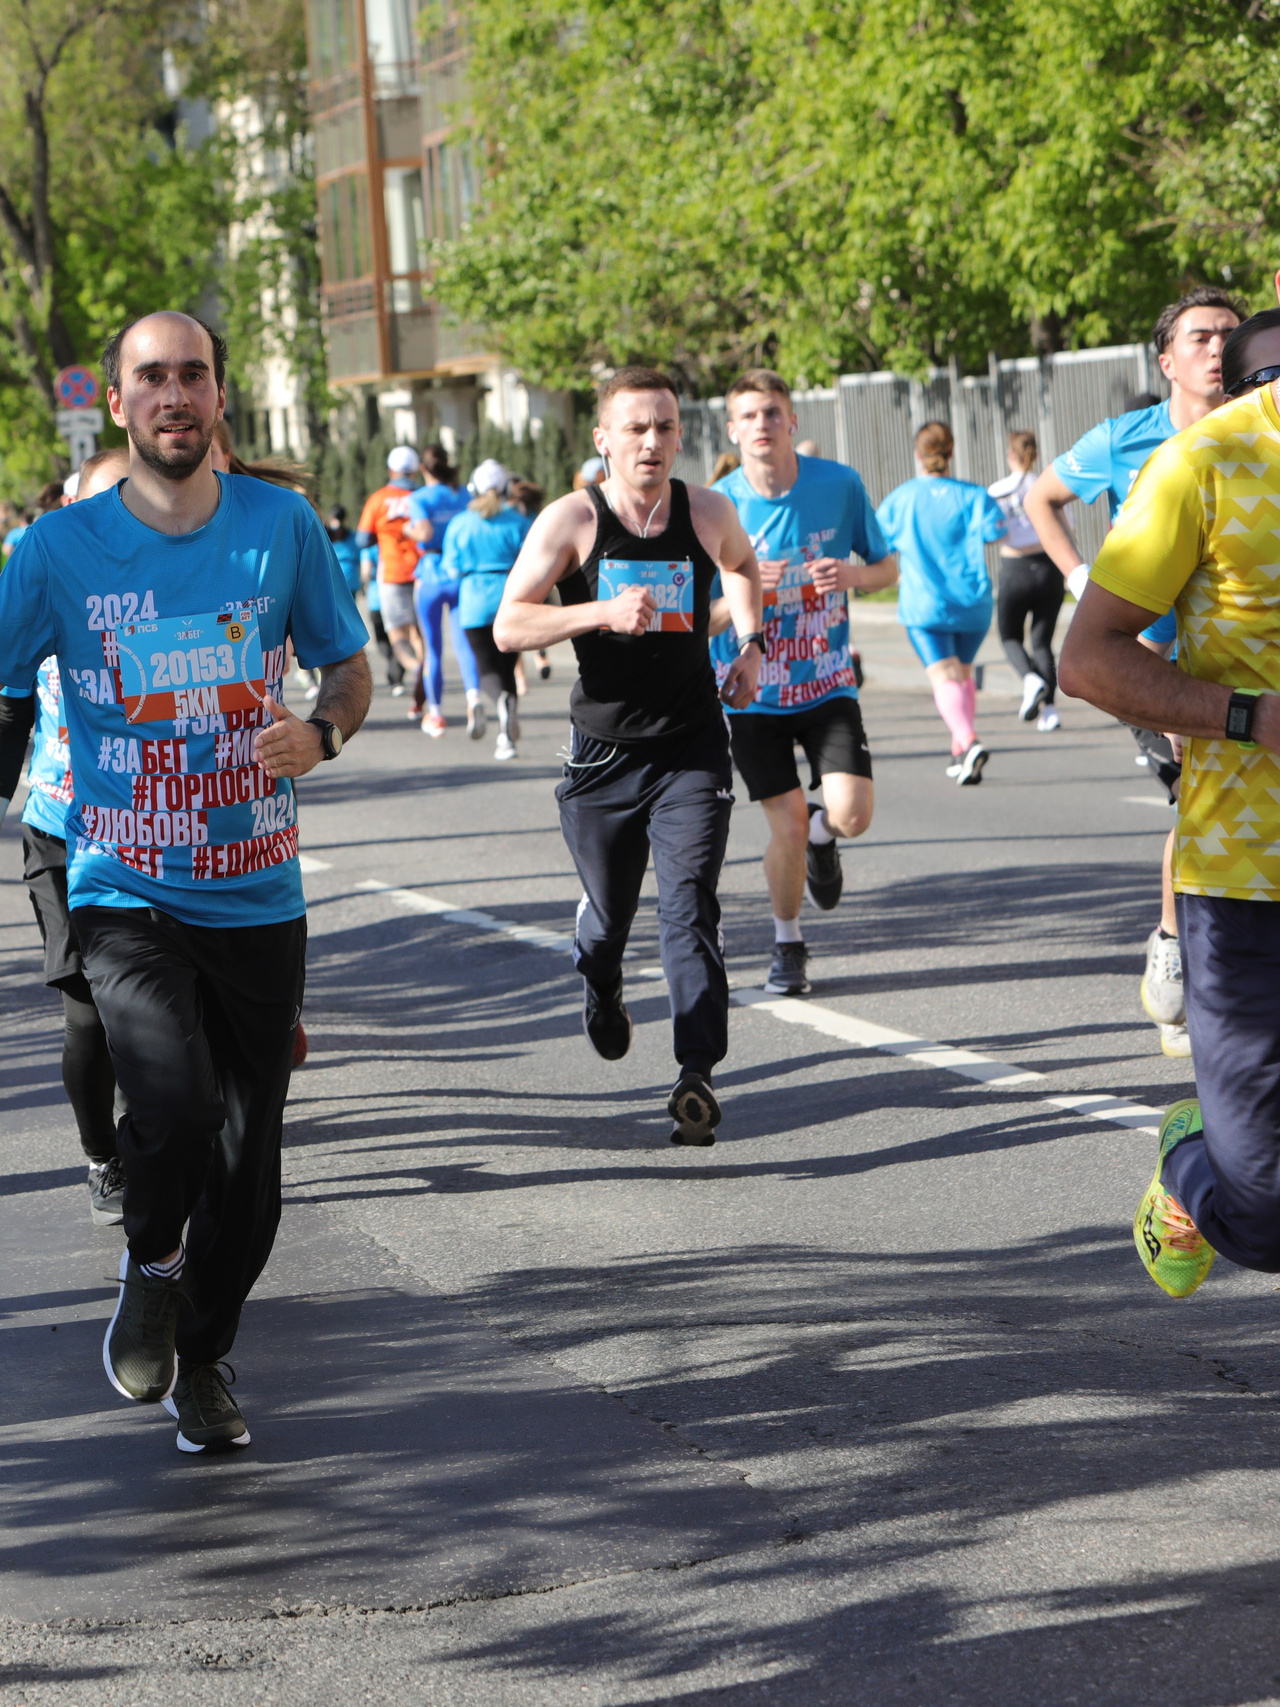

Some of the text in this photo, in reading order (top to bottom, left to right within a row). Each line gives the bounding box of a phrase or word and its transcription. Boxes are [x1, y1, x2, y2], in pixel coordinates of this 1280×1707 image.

[86, 590, 158, 631] 2024
[137, 623, 159, 634] ПСБ
[150, 644, 236, 688] 20153
[97, 736, 189, 774] #ЗАБЕГ
[132, 764, 277, 811] #ГОРДОСТЬ
[81, 804, 208, 847] #ЛЮБОВЬ
